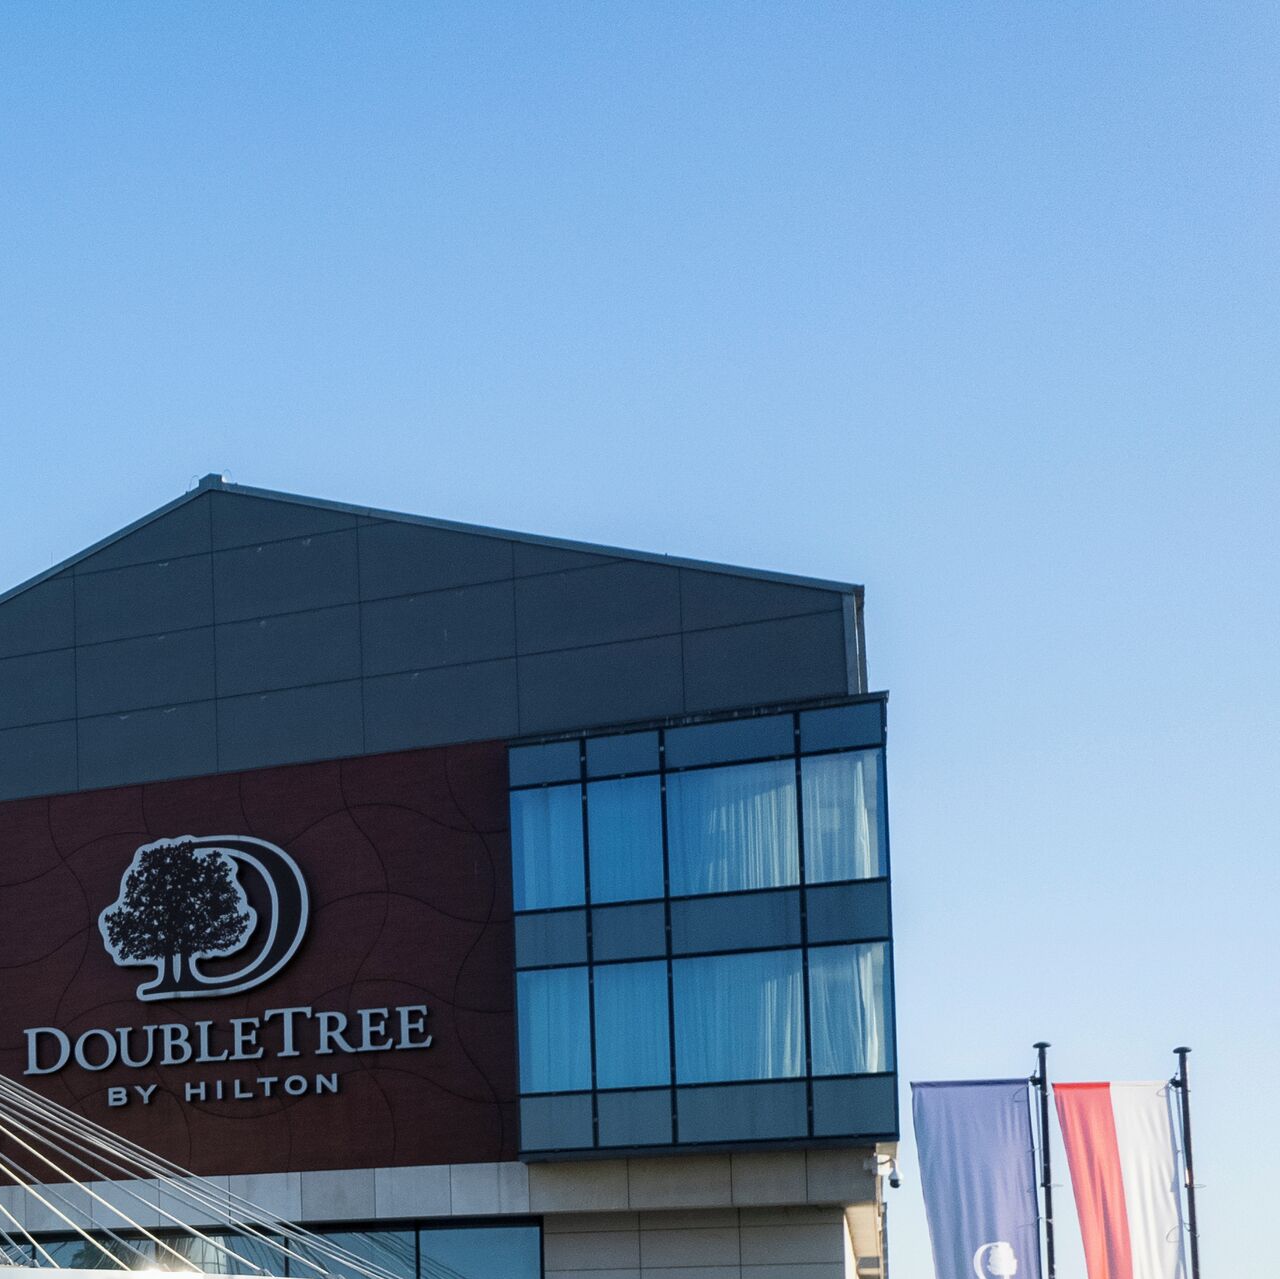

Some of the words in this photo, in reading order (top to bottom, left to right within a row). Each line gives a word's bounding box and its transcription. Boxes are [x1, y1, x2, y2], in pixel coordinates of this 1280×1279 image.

[23, 1004, 433, 1076] DOUBLETREE
[107, 1084, 158, 1107] BY
[184, 1072, 339, 1102] HILTON
